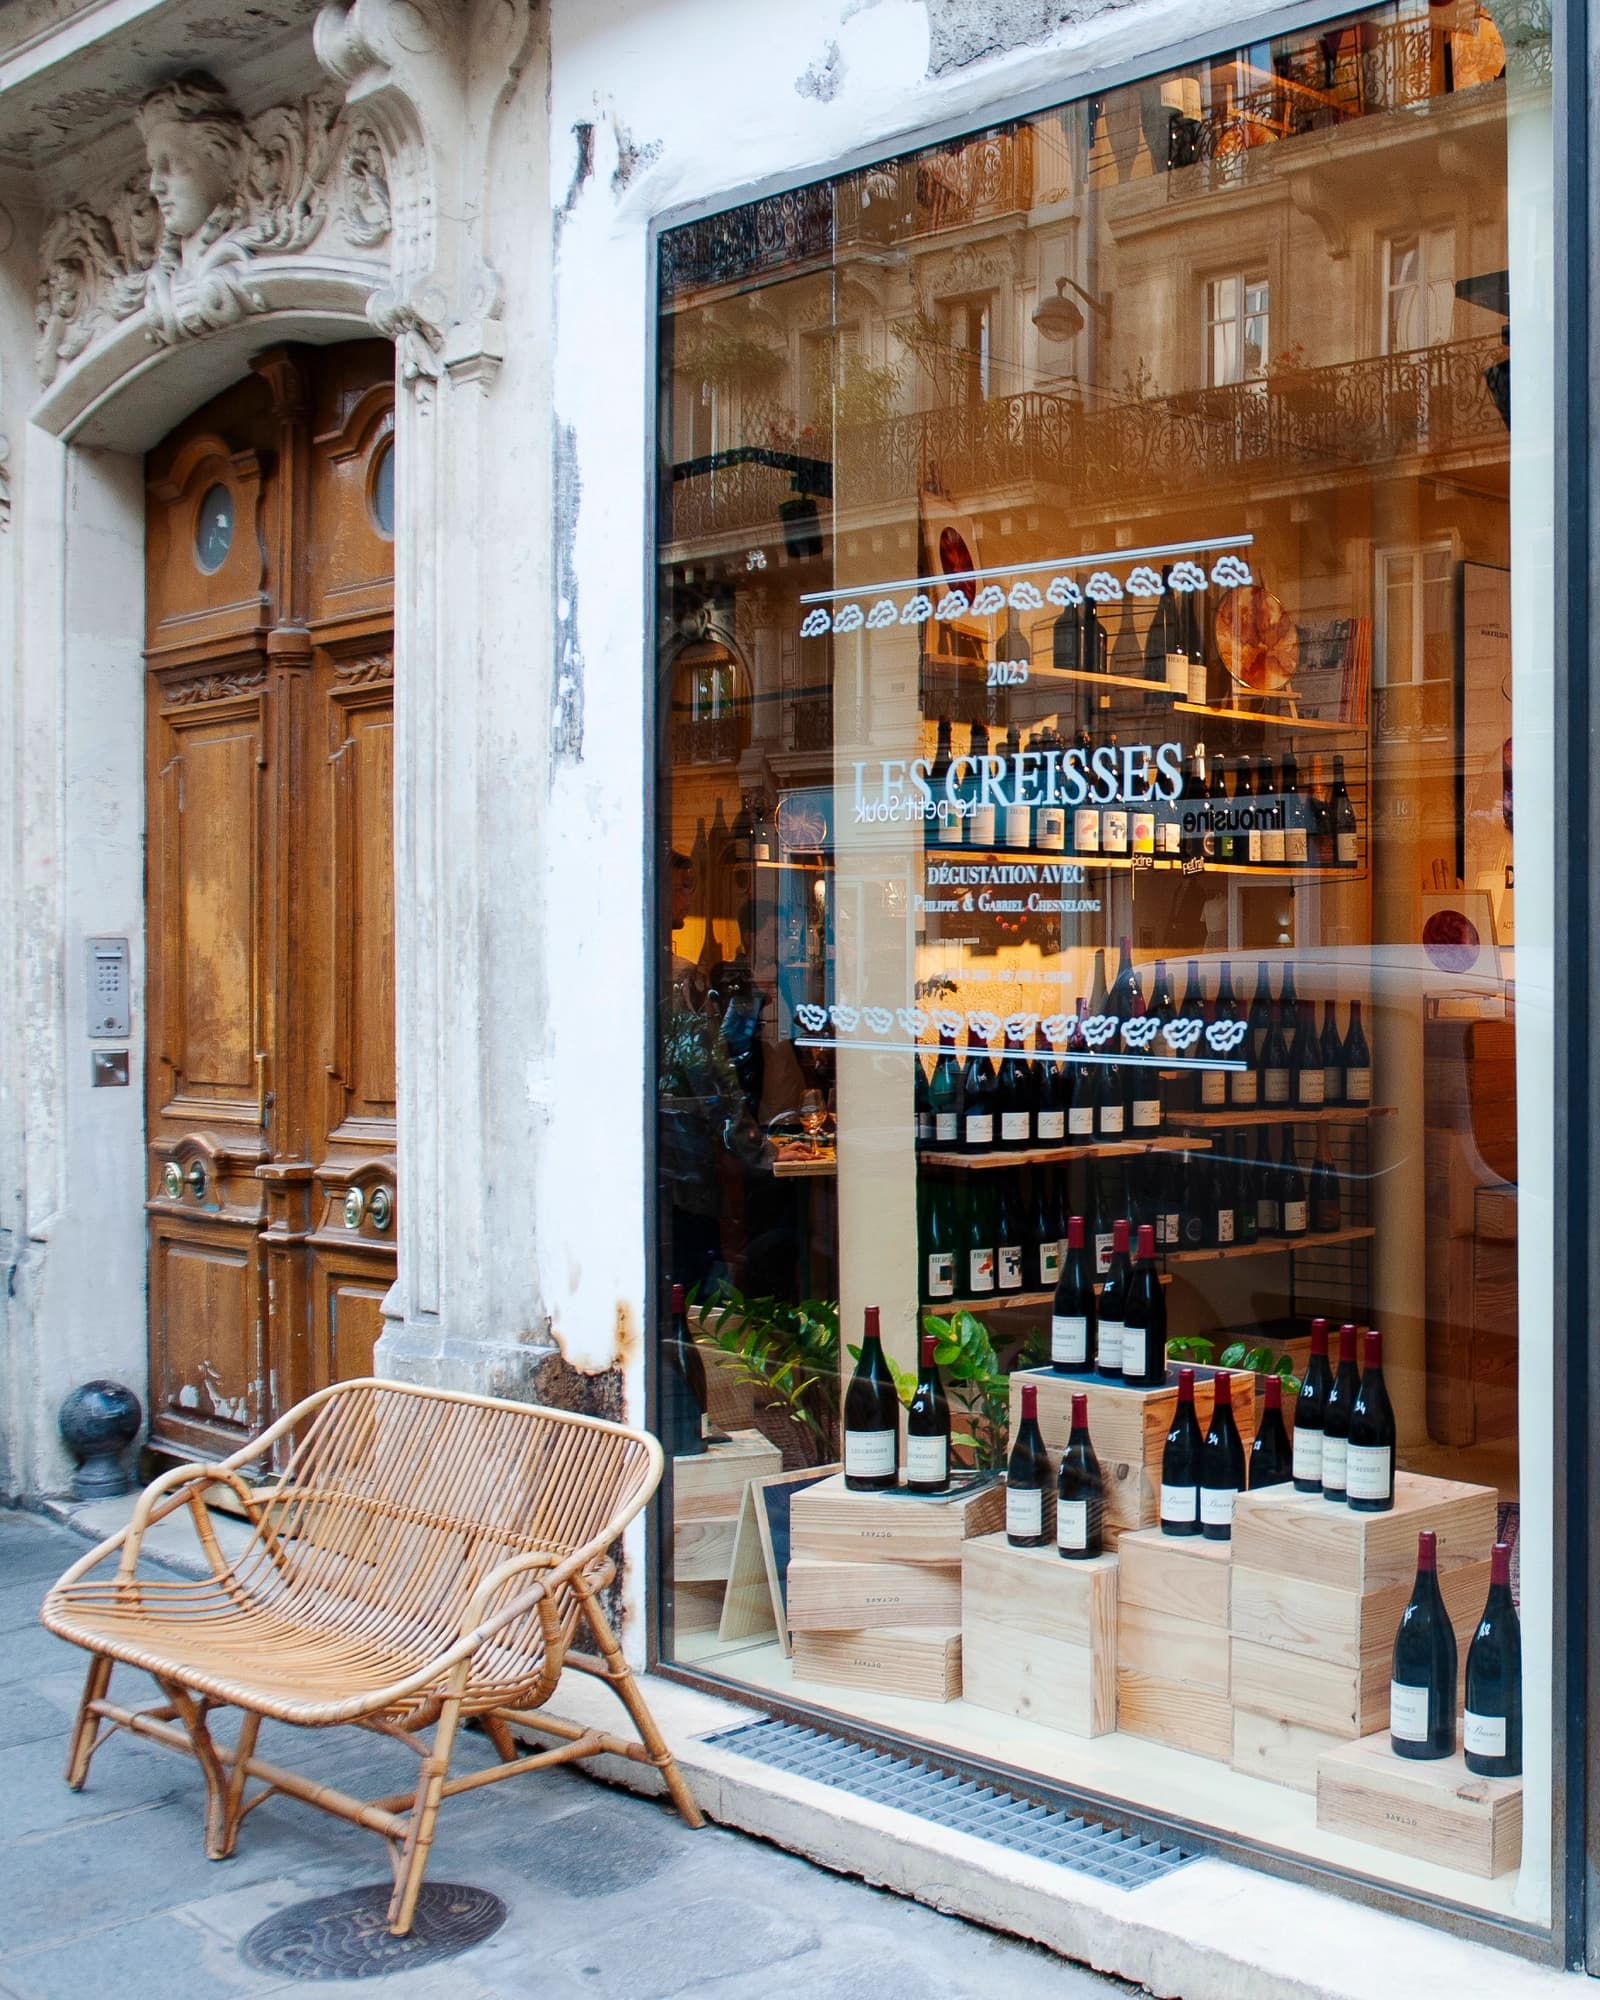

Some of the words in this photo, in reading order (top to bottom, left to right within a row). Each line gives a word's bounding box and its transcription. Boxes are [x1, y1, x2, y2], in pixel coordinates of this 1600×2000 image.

[986, 659, 1029, 686] 2023
[851, 758, 932, 810] LES
[945, 741, 1184, 808] CREISSES
[927, 862, 1038, 885] DÉGUSTATION
[1038, 863, 1085, 884] AVEC
[962, 892, 975, 912] &
